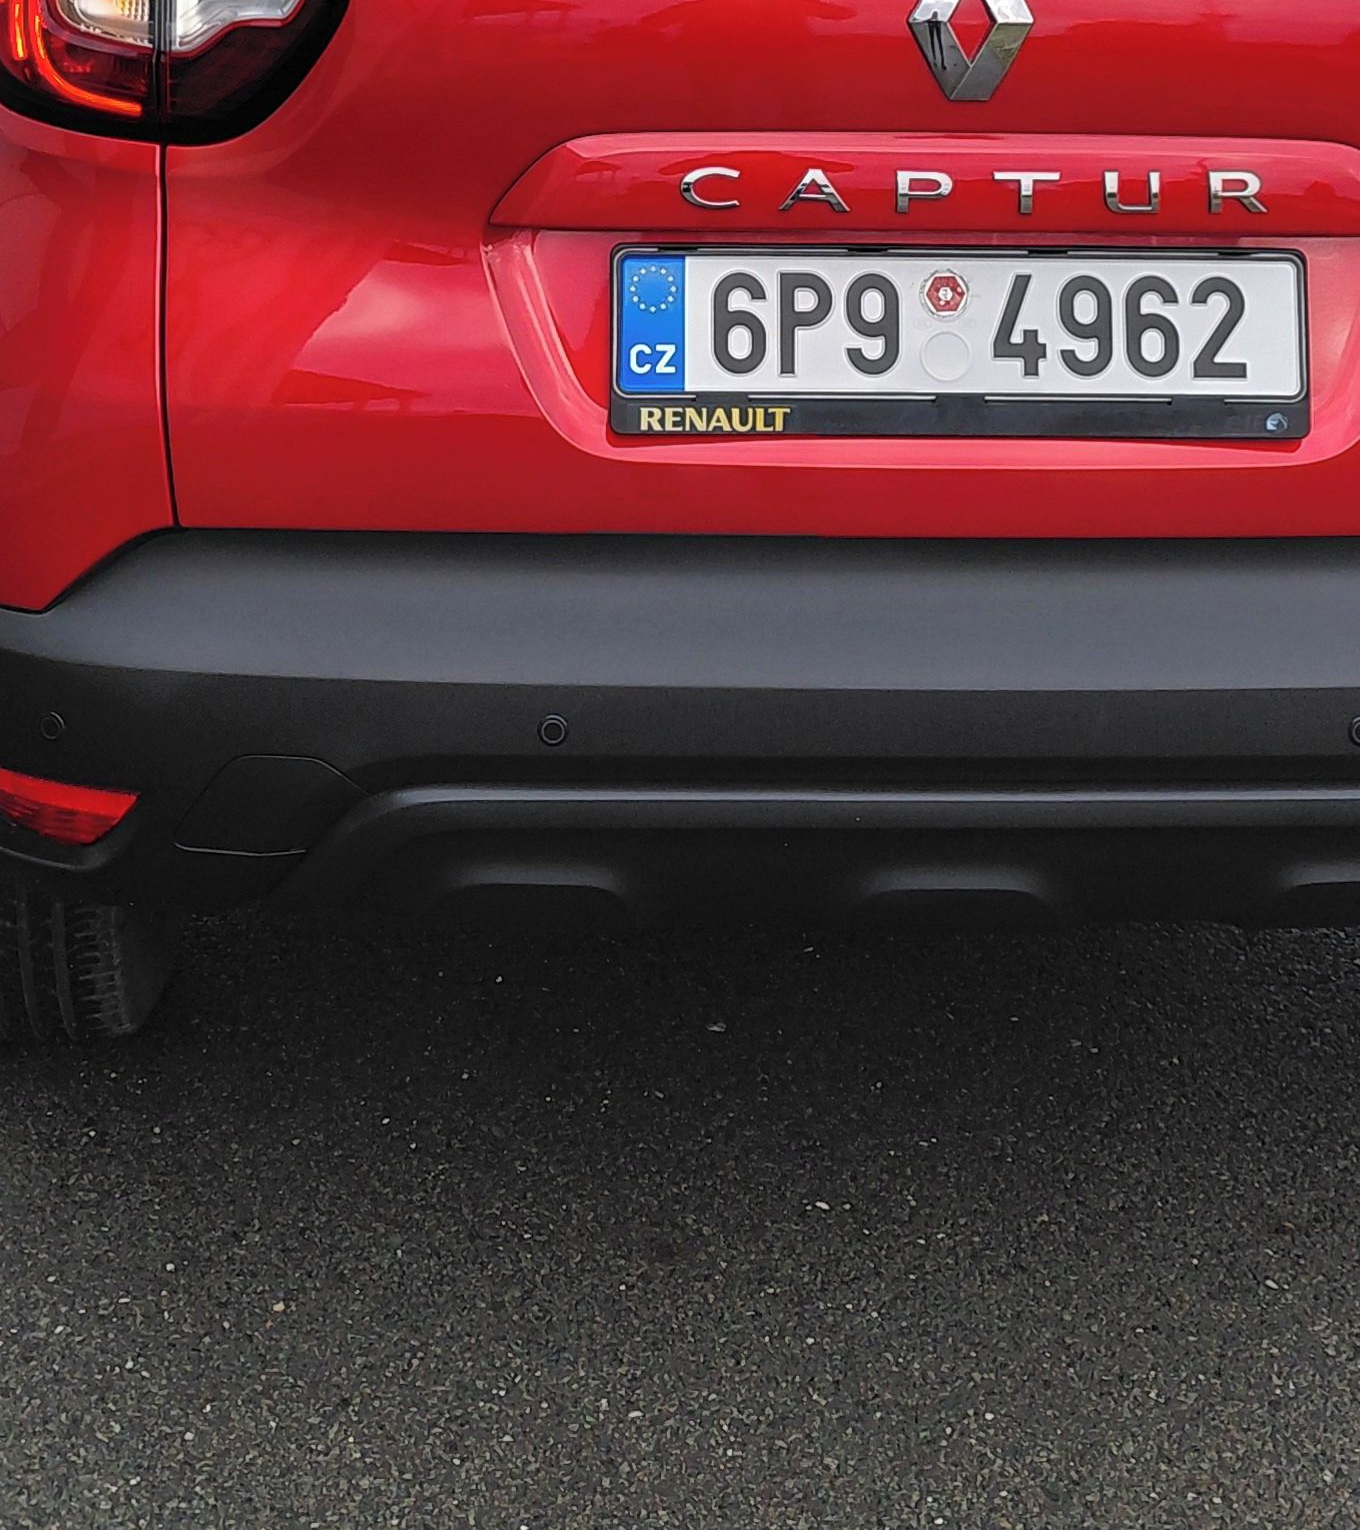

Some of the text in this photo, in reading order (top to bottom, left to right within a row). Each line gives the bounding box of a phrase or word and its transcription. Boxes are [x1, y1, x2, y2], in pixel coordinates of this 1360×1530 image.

[680, 166, 1268, 214] CAPTUR
[712, 271, 1248, 380] 6P9 4962
[629, 344, 677, 375] CZ
[639, 406, 791, 432] RENAULT
